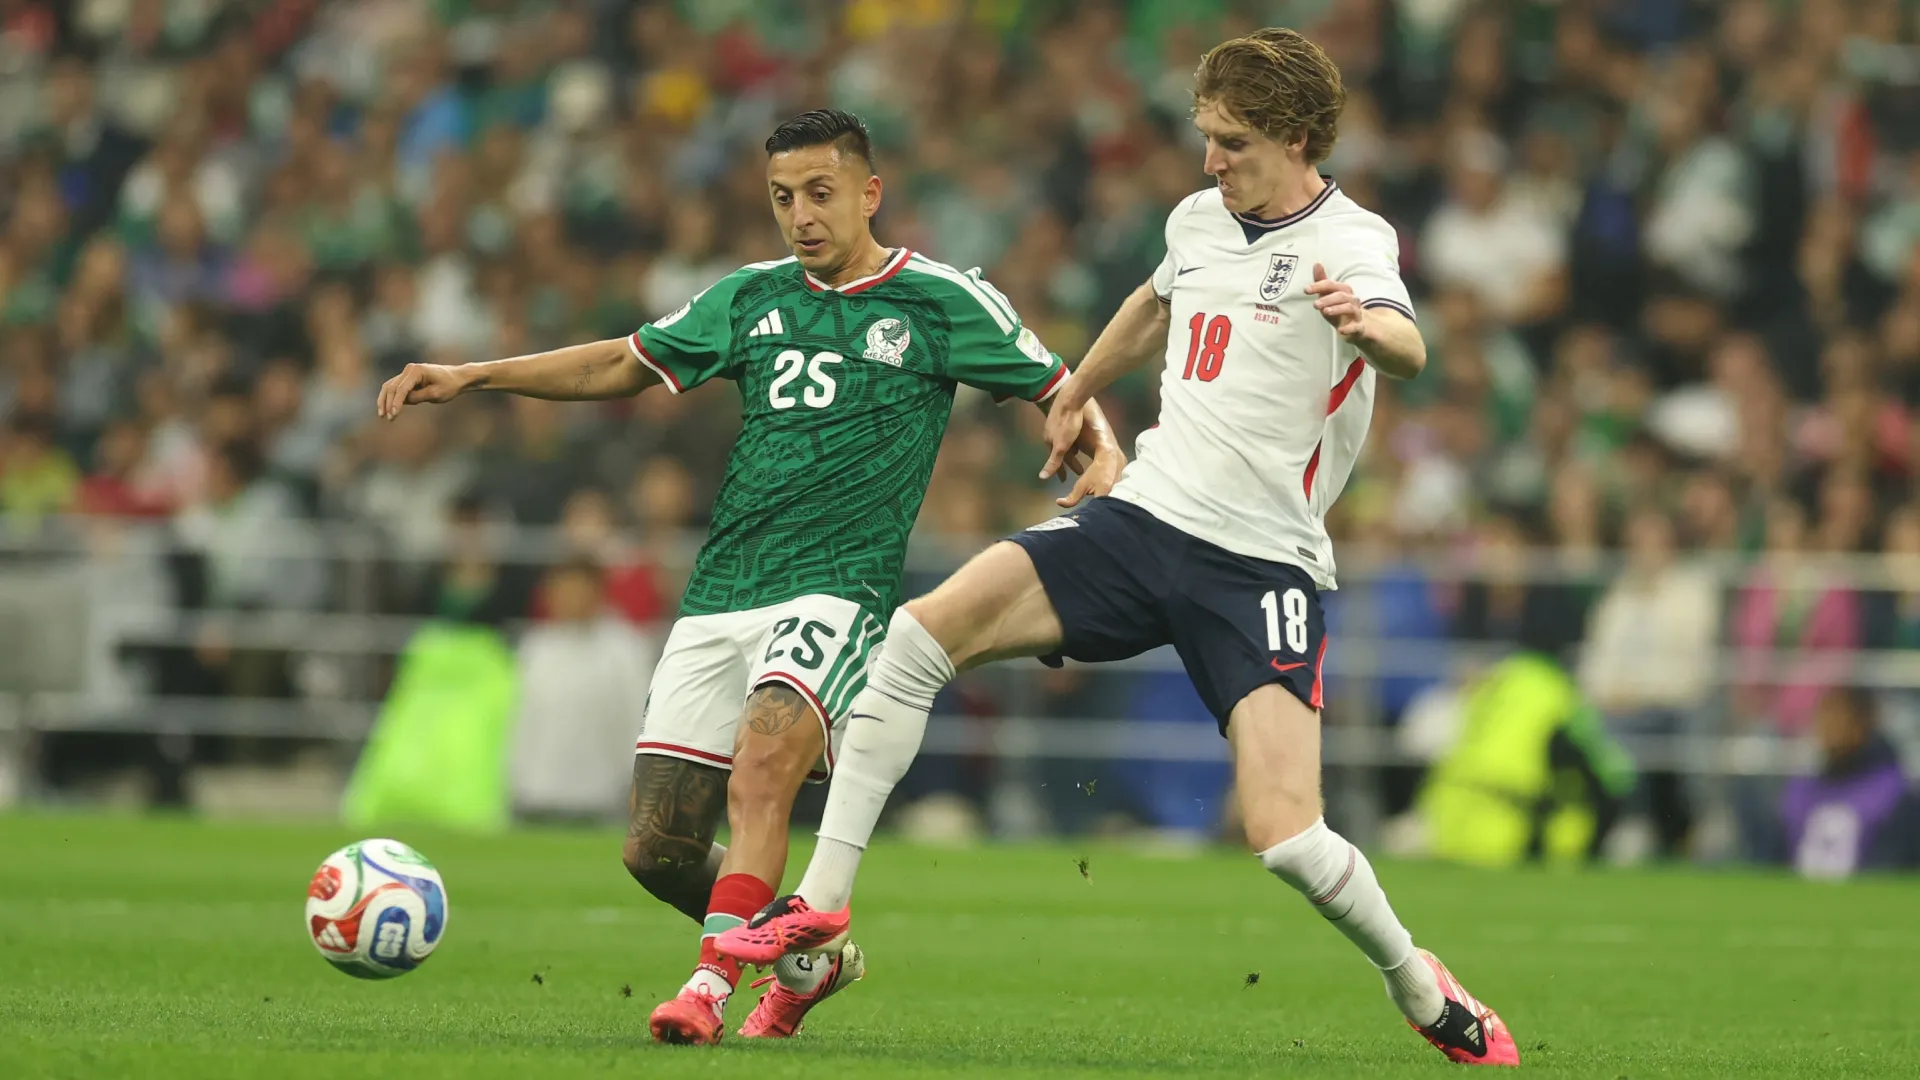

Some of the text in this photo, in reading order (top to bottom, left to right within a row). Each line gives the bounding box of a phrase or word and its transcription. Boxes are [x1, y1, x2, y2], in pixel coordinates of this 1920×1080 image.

[864, 351, 901, 365] MEXICO
[1182, 312, 1232, 382] 18
[769, 350, 843, 409] 25
[764, 617, 836, 670] 25
[1260, 588, 1308, 654] 18
